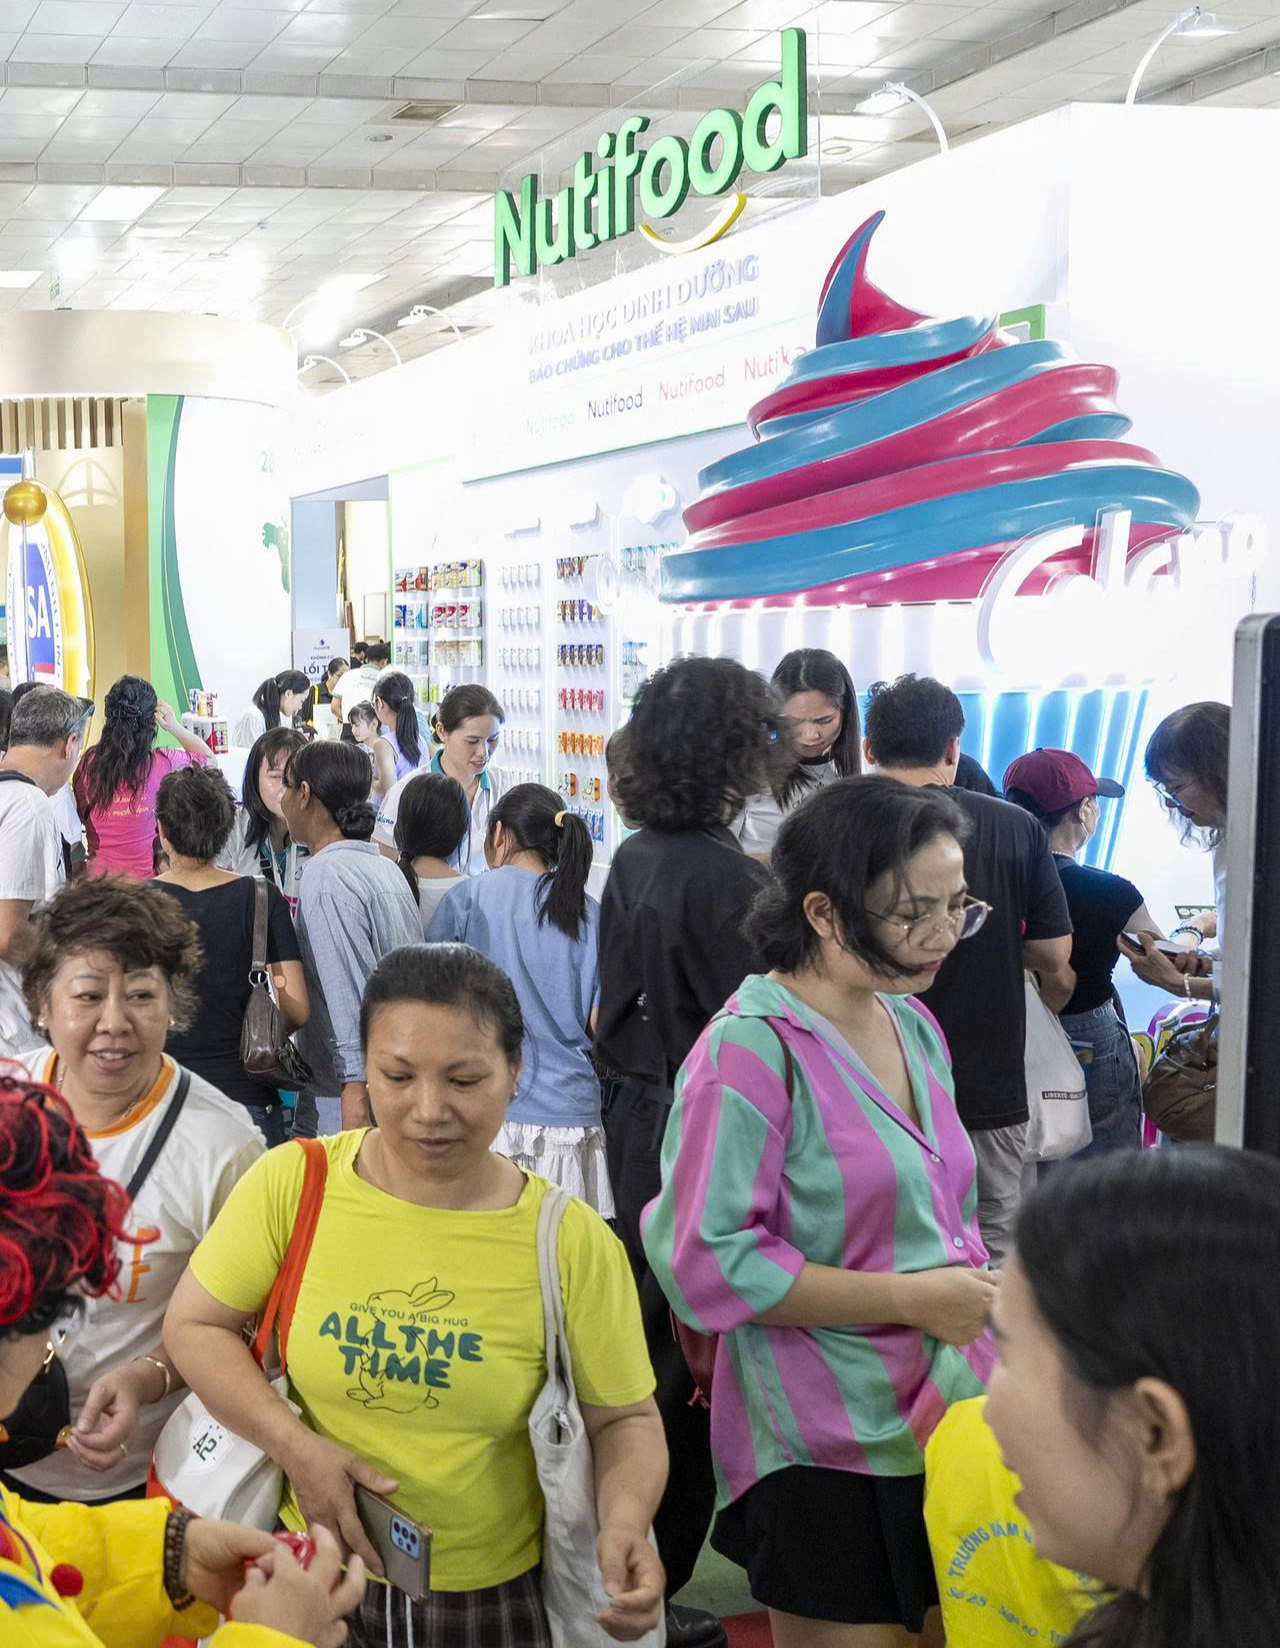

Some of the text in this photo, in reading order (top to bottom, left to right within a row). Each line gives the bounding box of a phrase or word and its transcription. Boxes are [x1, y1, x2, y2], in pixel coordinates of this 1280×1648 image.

[494, 27, 808, 289] Nutifood
[723, 297, 759, 324] SAU
[587, 387, 644, 422] Nutifood
[658, 366, 726, 402] Nutifood
[743, 346, 807, 382] Nutik
[303, 662, 320, 675] LỐI
[319, 1311, 484, 1362] ALL THE
[350, 1302, 469, 1328] GIVE YOU A BIG HUG
[338, 1345, 452, 1389] TIME
